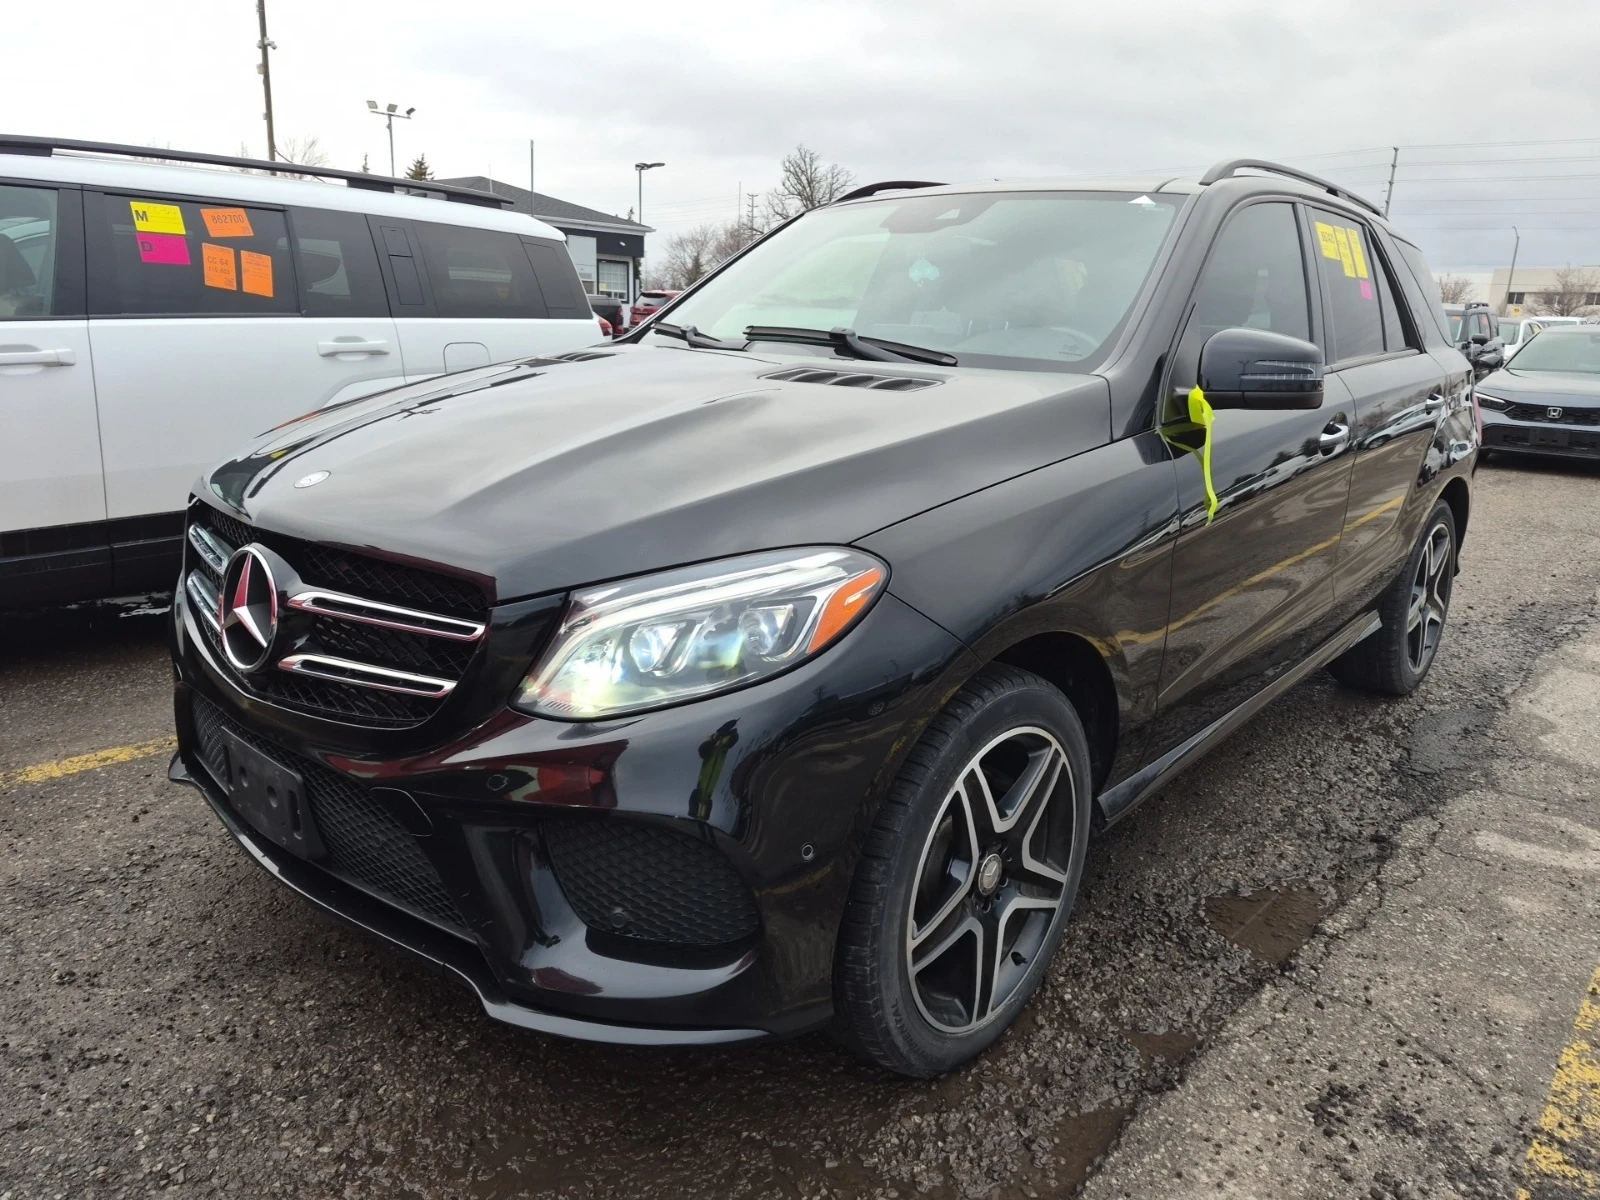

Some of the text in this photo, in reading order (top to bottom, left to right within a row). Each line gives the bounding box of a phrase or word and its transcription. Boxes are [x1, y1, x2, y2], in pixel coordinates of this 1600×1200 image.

[134, 209, 149, 222] M
[211, 214, 245, 224] 862700
[141, 241, 153, 252] D
